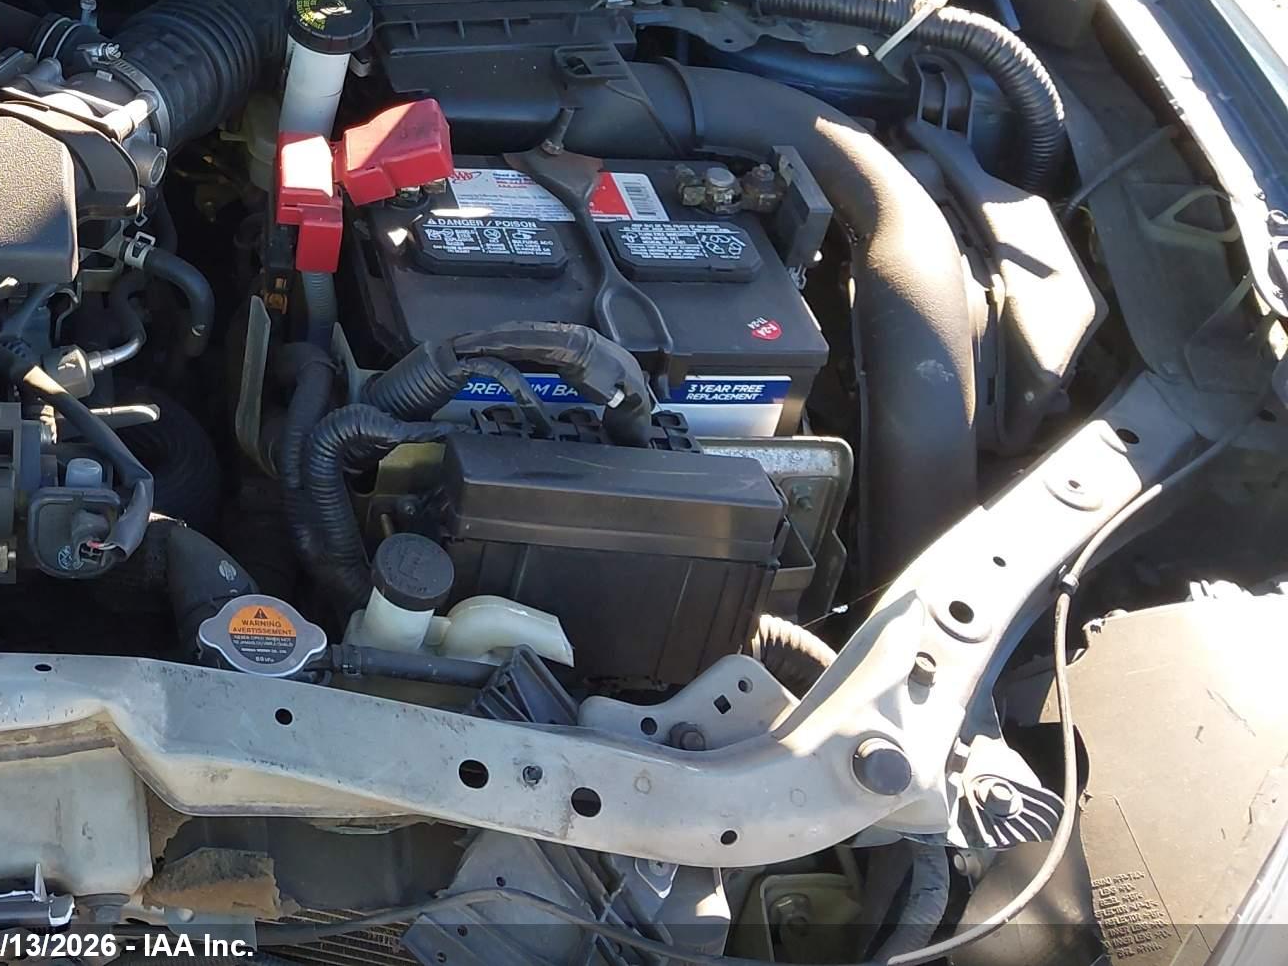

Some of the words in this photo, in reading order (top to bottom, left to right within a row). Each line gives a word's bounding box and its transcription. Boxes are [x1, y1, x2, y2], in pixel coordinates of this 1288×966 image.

[437, 219, 484, 227] DANGER
[495, 220, 538, 228] POISON
[688, 384, 698, 393] 3
[699, 384, 731, 393] YEAR
[732, 384, 766, 393] FREE
[686, 393, 761, 401] REPLACEMENT
[241, 619, 282, 628] WARNING
[232, 627, 293, 635] AVERTISSEMENT
